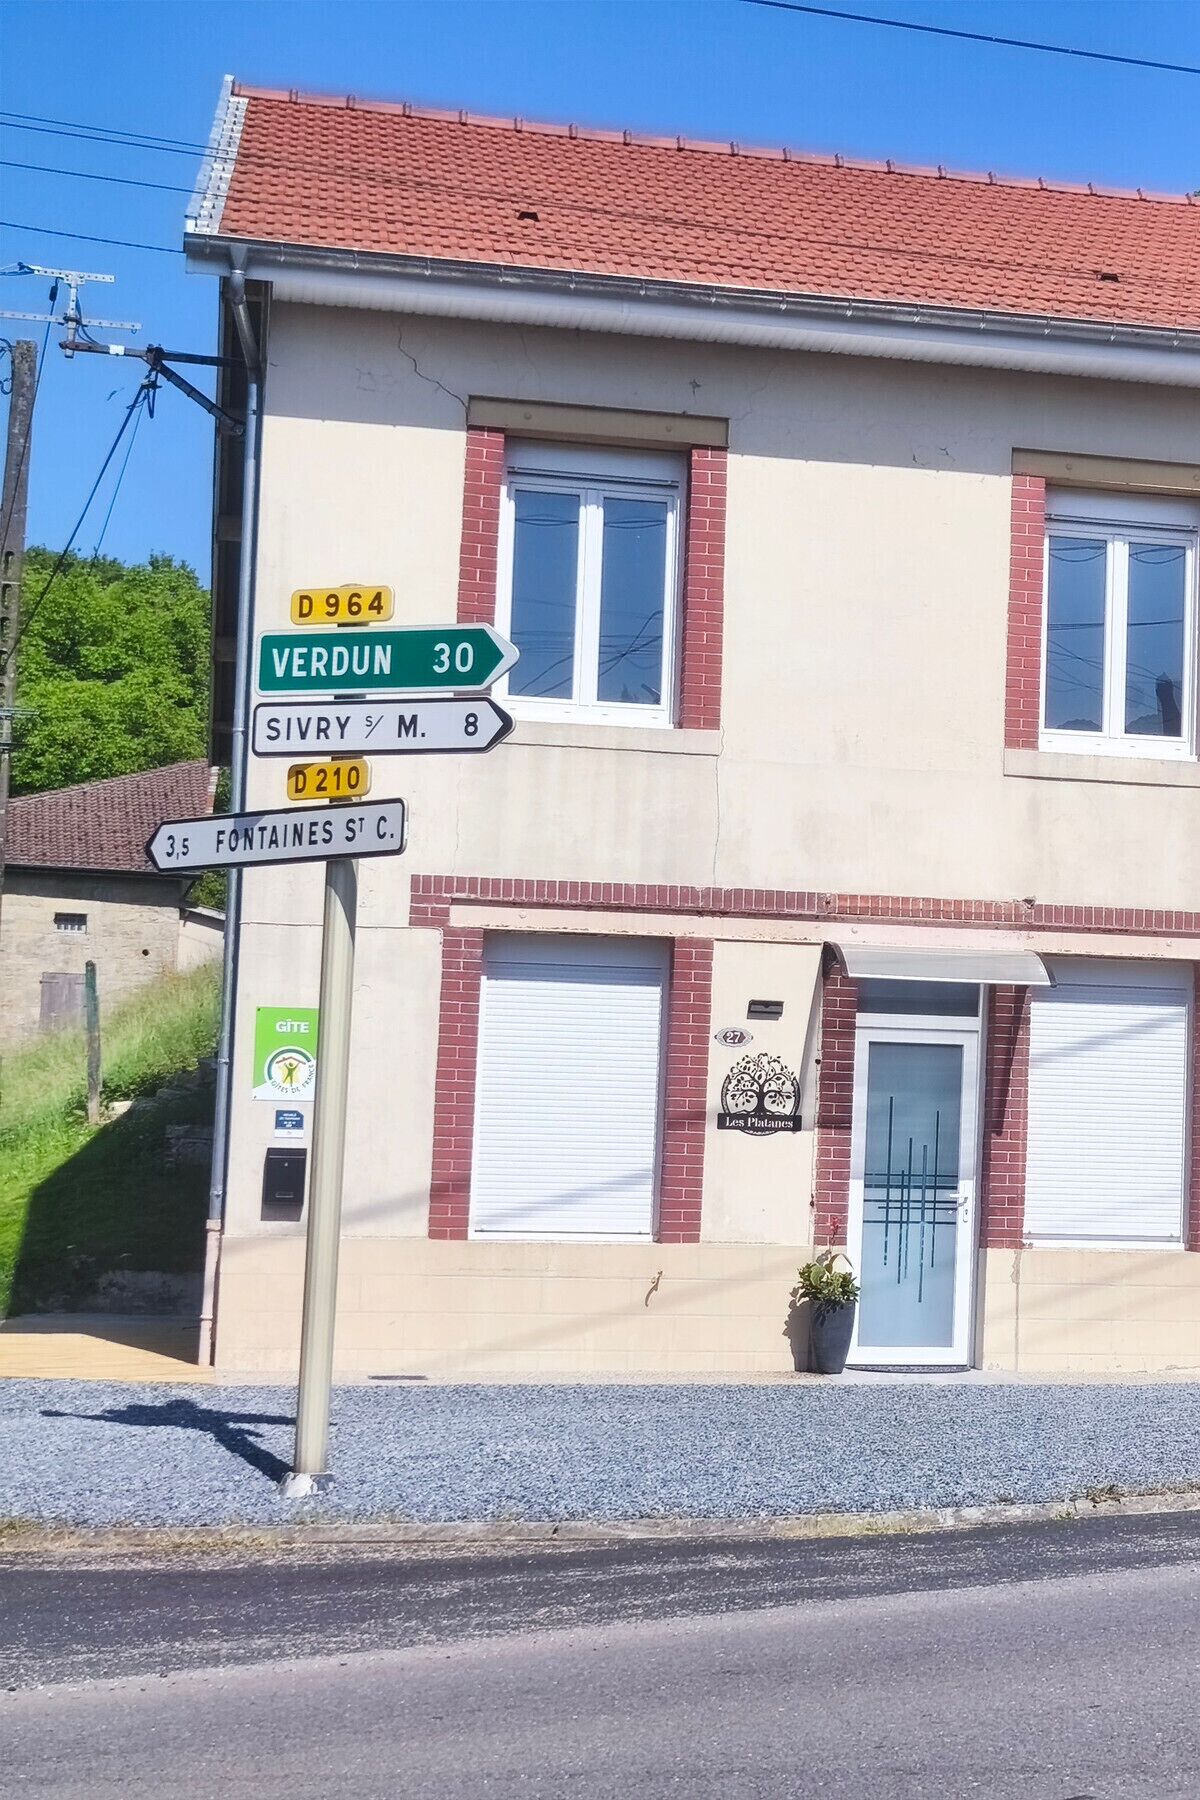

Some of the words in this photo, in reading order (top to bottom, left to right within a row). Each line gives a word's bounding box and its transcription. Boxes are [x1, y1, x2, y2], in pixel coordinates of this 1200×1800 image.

[298, 594, 313, 618] D
[324, 591, 385, 617] 964
[272, 644, 392, 678] VERDUN
[432, 641, 474, 674] 30
[266, 715, 351, 741] SIVRY
[397, 714, 426, 739] M.
[464, 712, 479, 736] 8
[295, 770, 307, 793] D
[315, 765, 361, 791] 210
[166, 834, 190, 861] 3,5
[215, 819, 333, 853] FONTAINES
[376, 815, 395, 840] C.
[275, 1018, 310, 1033] GÎTE
[725, 1031, 741, 1043] 27
[725, 1116, 745, 1128] Les
[747, 1117, 794, 1129] Platanes
